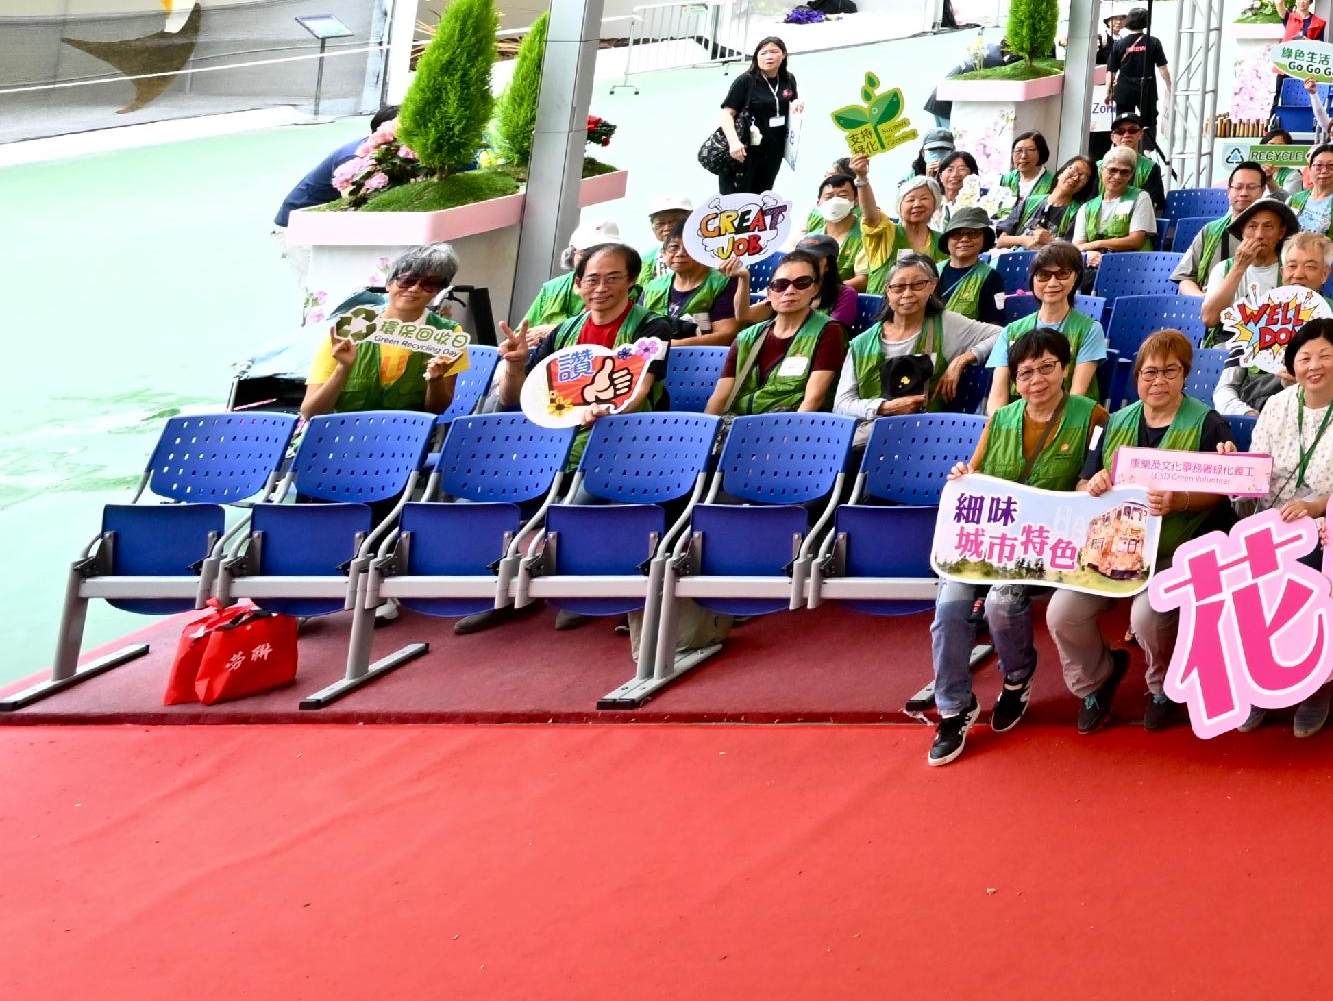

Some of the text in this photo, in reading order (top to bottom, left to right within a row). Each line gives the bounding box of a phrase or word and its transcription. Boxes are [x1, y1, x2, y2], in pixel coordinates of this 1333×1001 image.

[1281, 46, 1332, 67] 綠色生活
[1288, 61, 1304, 71] Go
[1305, 63, 1321, 74] Go
[849, 127, 874, 142] 支持
[1250, 150, 1303, 162] RECYCLE
[700, 205, 787, 237] GREAT
[718, 235, 763, 260] JOB
[1237, 303, 1304, 326] WELL
[379, 320, 472, 349] 環保回收日
[1259, 326, 1292, 349] DO
[374, 335, 461, 359] Green Recycling Day
[559, 349, 594, 386] 讚
[1130, 457, 1254, 478] 康樂及文化事務署綠化義工
[1152, 472, 1231, 486] CSD Green Volunteer
[954, 492, 1018, 527] 細味
[955, 525, 1077, 571] 城市特色
